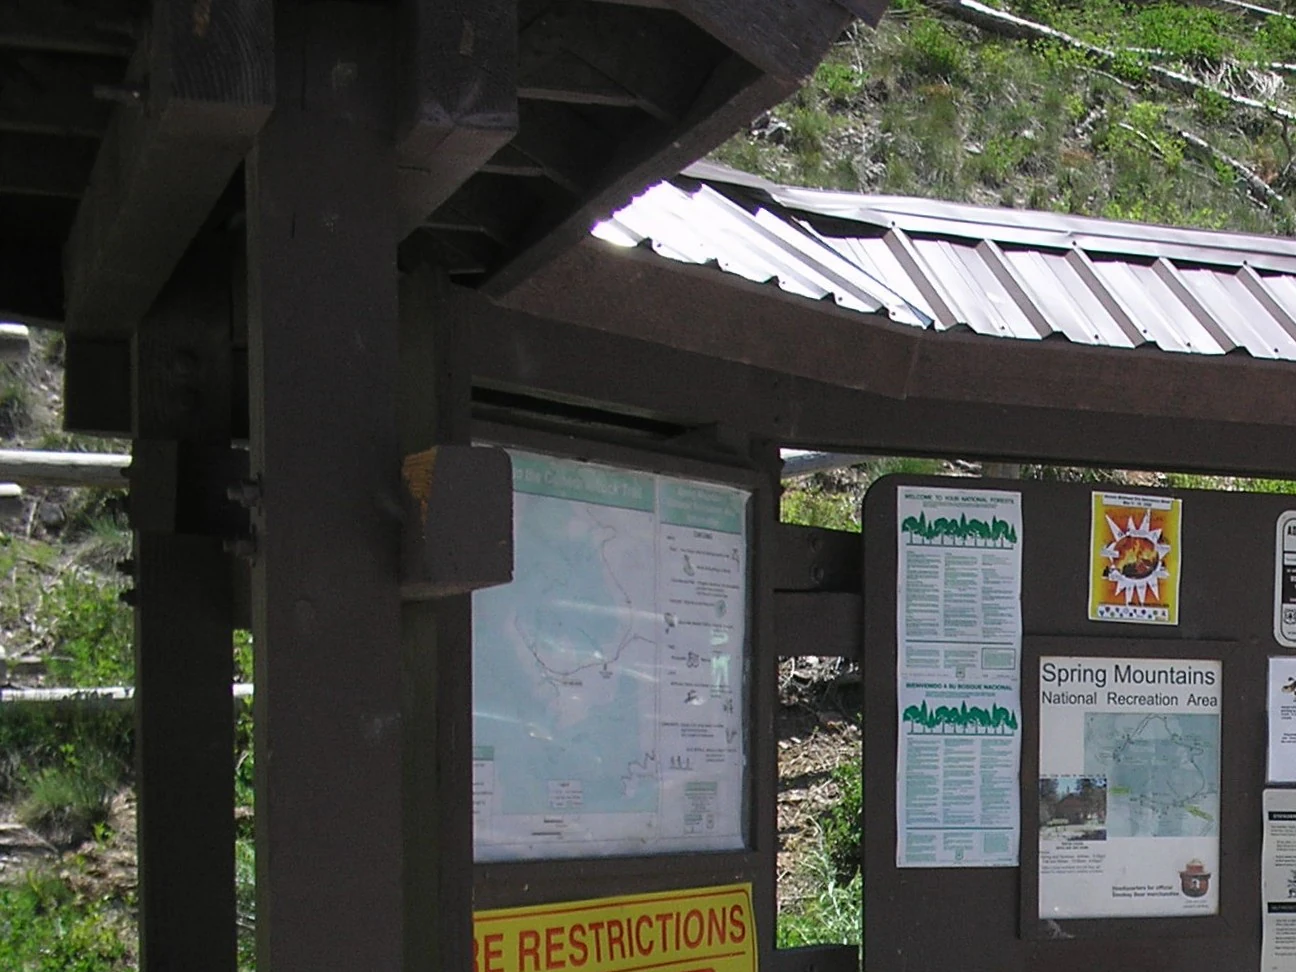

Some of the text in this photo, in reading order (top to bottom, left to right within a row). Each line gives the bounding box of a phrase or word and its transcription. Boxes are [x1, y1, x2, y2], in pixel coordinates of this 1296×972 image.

[1042, 662, 1216, 688] Spring Mountains
[1042, 691, 1218, 707] National Recreation Area
[518, 904, 746, 972] RESTRICTIONS
